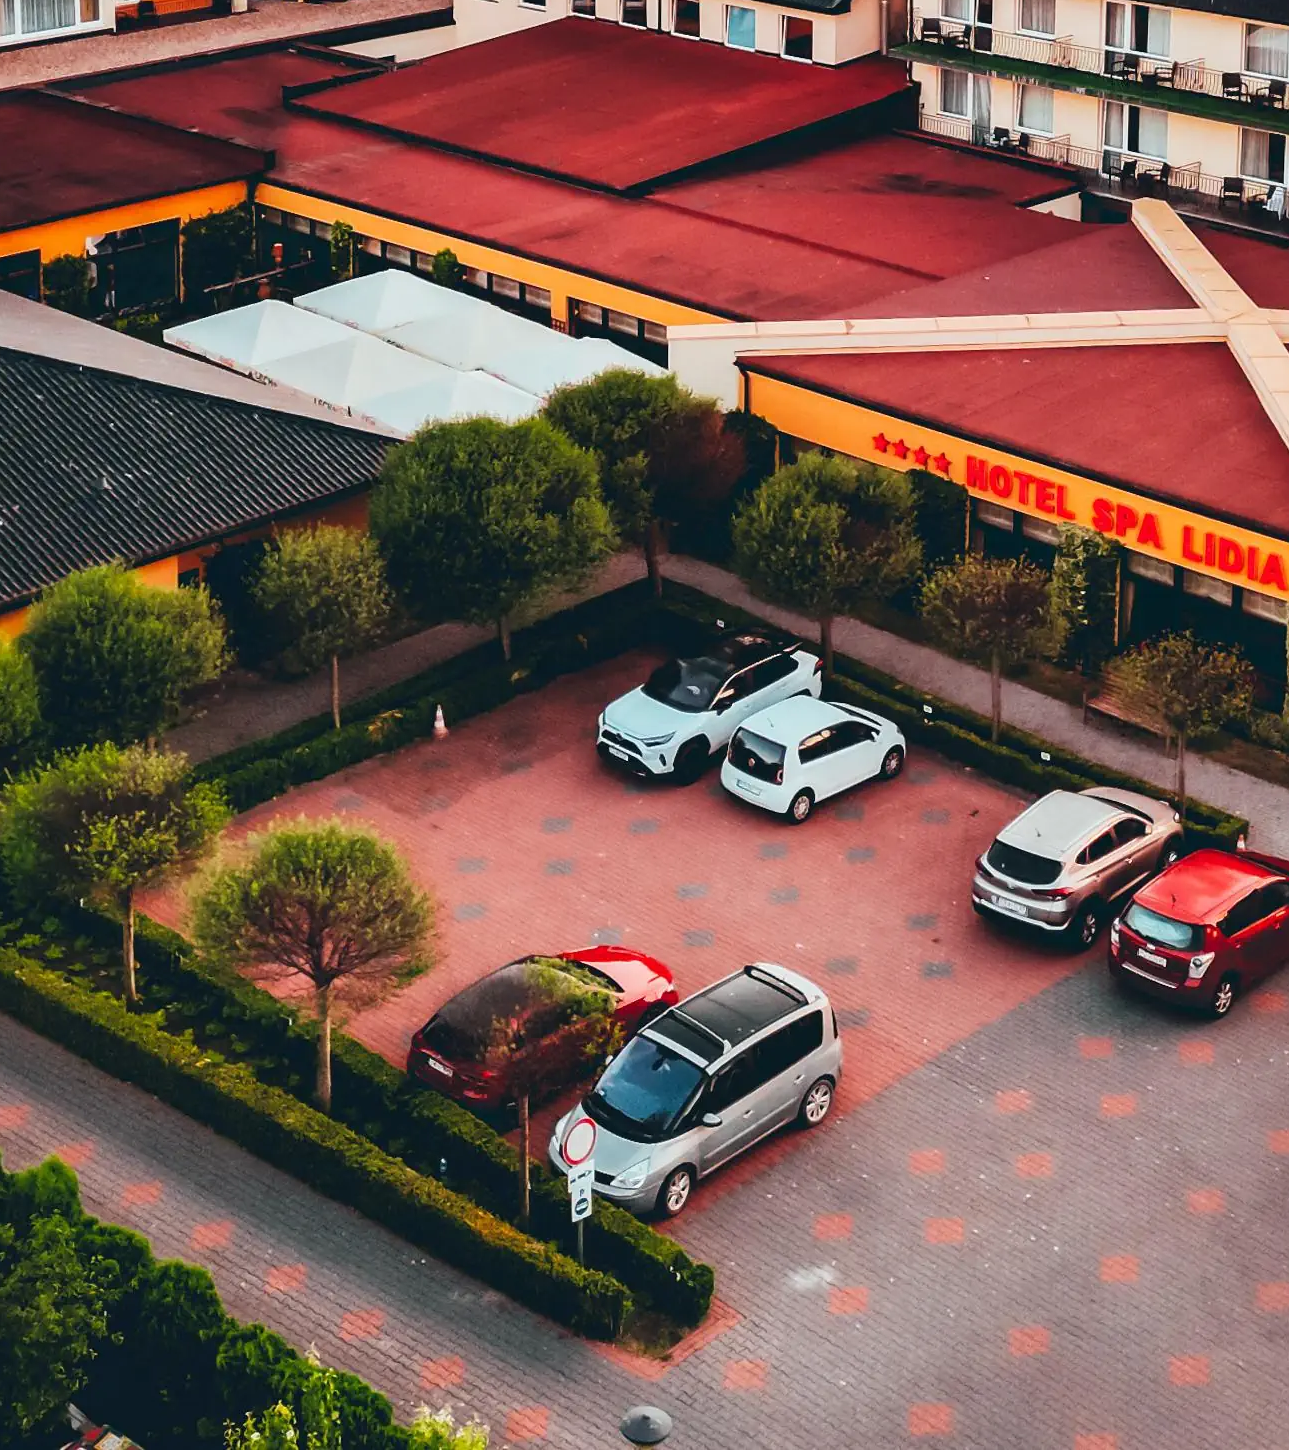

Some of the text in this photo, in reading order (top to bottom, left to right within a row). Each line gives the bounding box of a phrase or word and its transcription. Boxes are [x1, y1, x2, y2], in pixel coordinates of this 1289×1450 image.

[966, 453, 1289, 591] HOTEL SPA LIDIA
